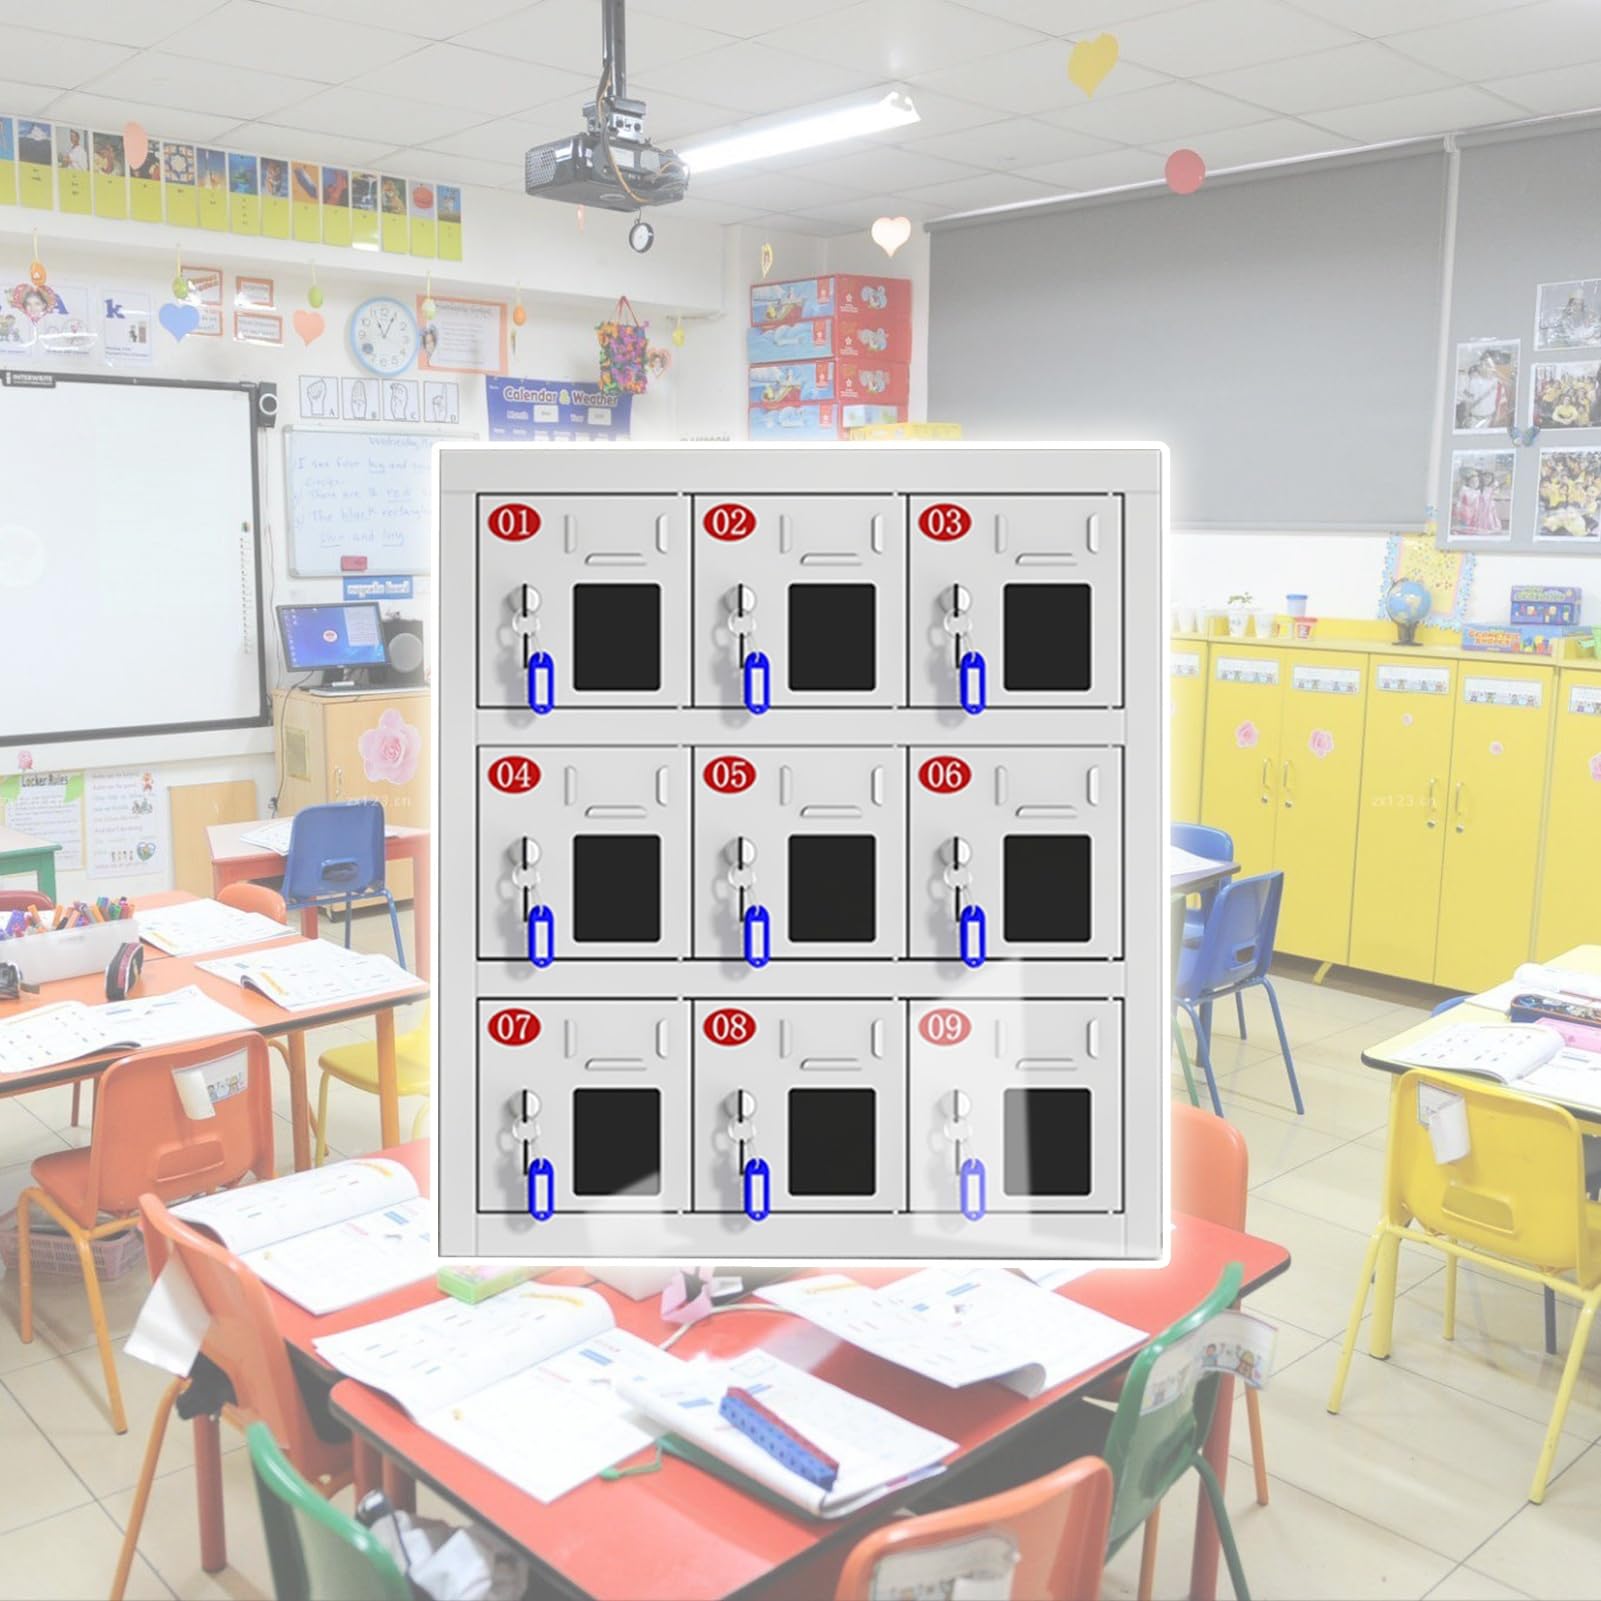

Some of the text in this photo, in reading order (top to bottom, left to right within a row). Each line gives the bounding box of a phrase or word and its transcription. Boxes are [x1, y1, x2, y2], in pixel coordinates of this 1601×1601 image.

[105, 299, 125, 319] k
[504, 385, 618, 407] Calendar Weather
[498, 509, 529, 535] 01
[713, 509, 746, 535] 02
[928, 509, 962, 535] 03
[497, 761, 530, 787] 04
[713, 761, 746, 788] 05
[928, 761, 962, 788] 06
[498, 1014, 530, 1040] 07
[713, 1014, 746, 1040] 08
[928, 1014, 962, 1040] 09
